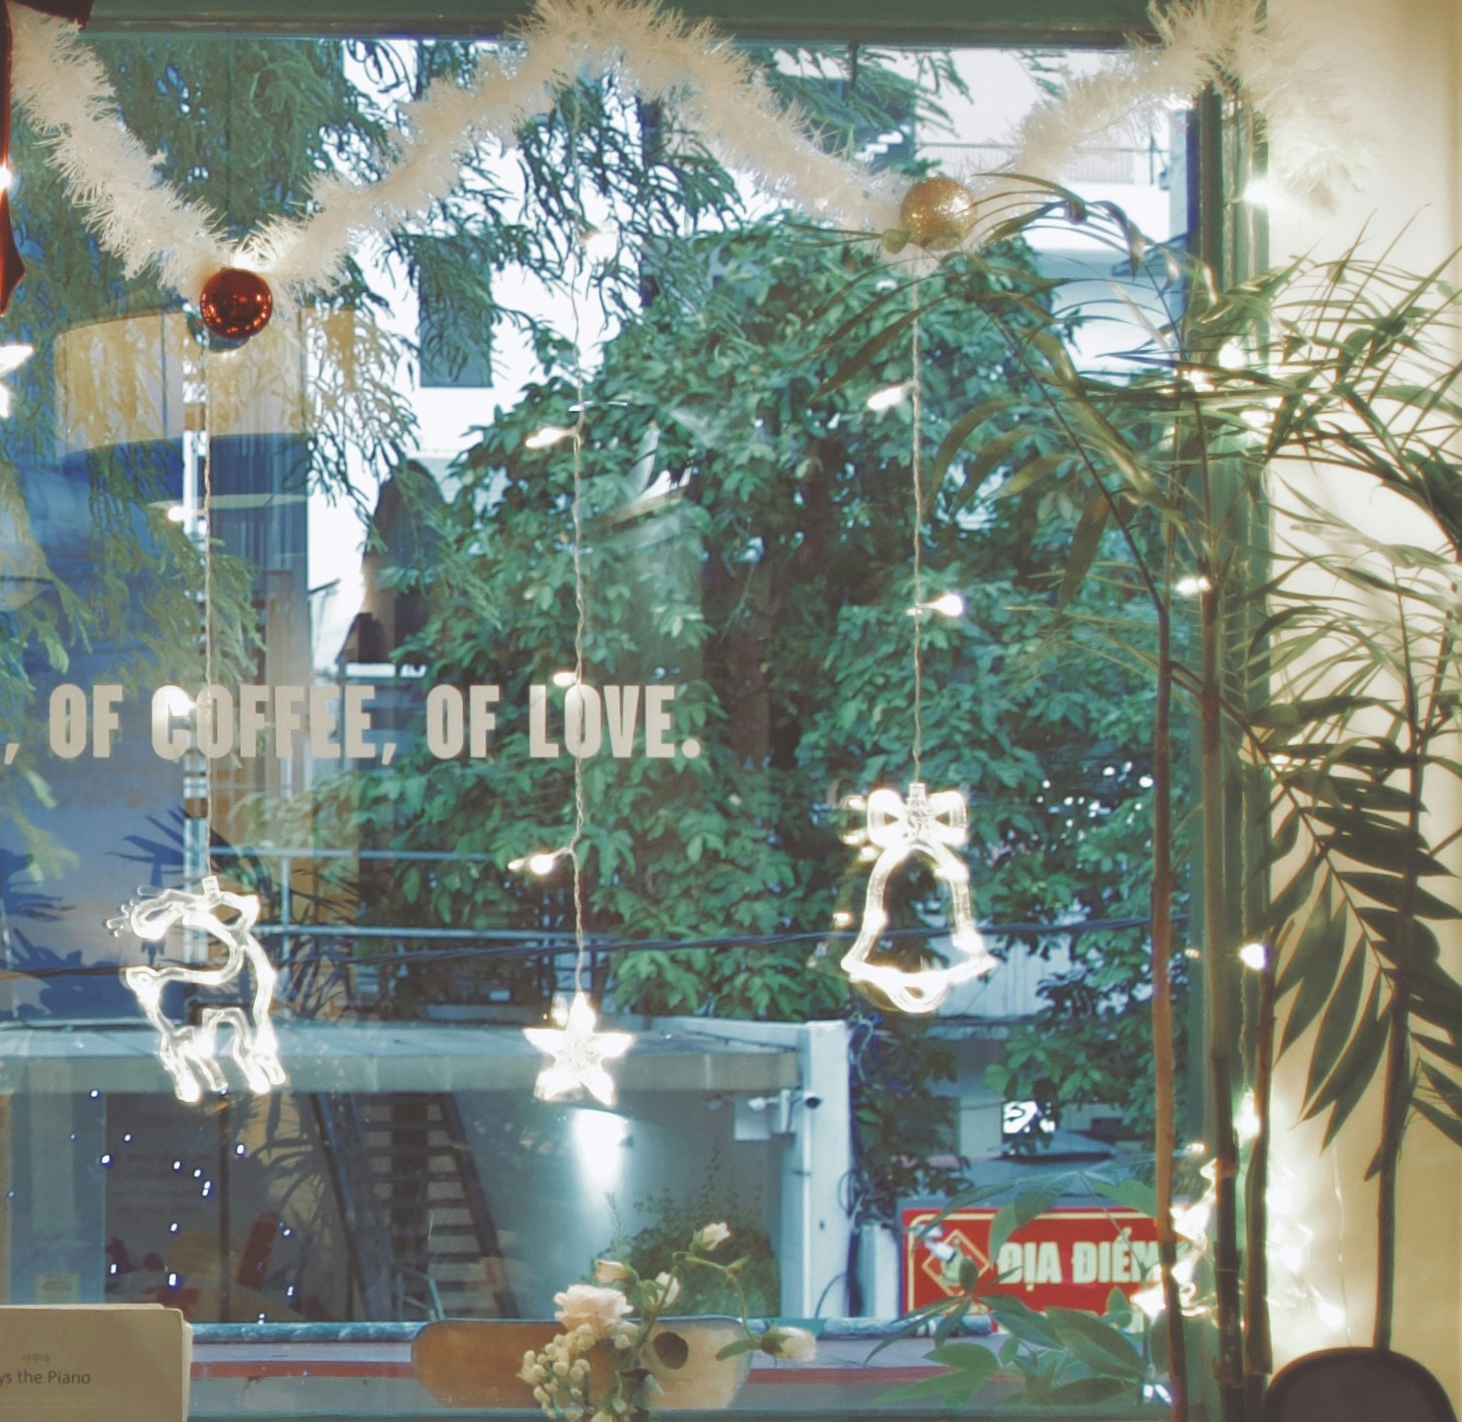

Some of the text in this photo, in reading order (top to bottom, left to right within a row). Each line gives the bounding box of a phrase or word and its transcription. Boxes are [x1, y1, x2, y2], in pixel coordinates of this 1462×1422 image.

[49, 684, 124, 759] OF
[150, 683, 398, 767] COFFEE,
[425, 684, 500, 759] OF
[528, 684, 701, 759] LOVE.
[17, 1369, 43, 1384] the
[48, 1370, 92, 1385] Piano
